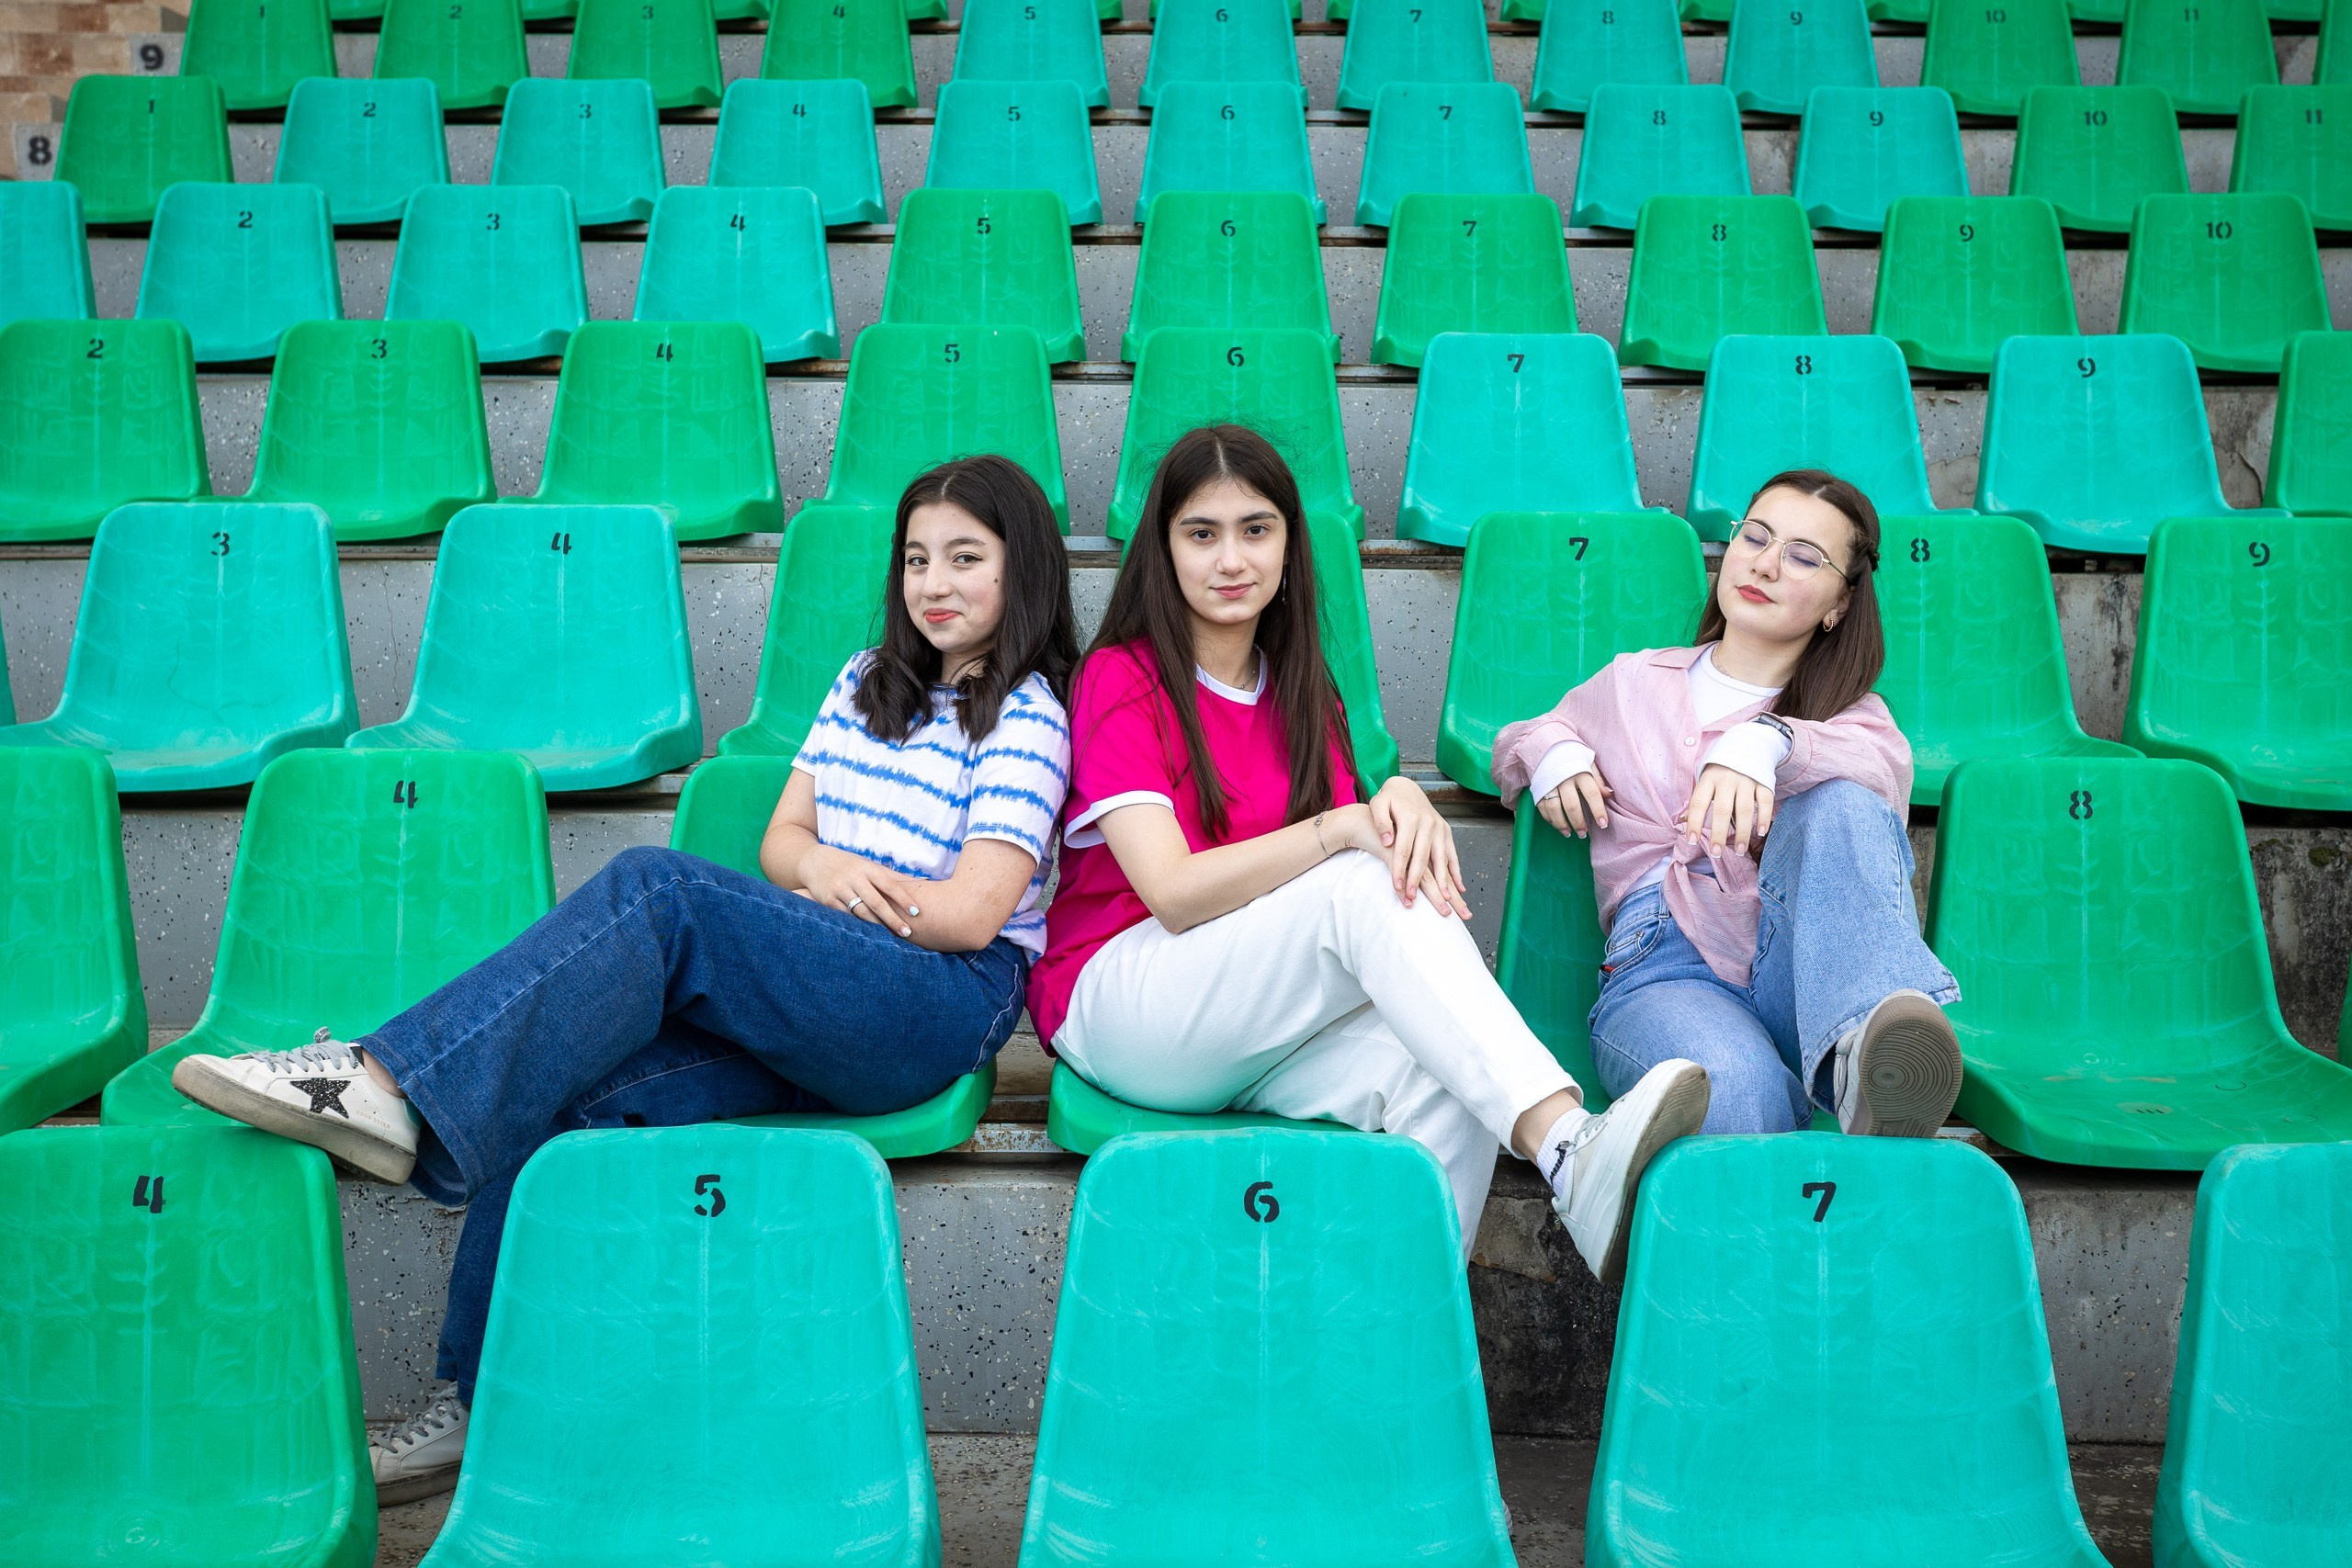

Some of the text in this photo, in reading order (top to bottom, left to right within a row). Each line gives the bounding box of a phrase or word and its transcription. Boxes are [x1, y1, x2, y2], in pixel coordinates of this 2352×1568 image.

[258, 4, 266, 19] 1
[448, 5, 463, 20] 2
[641, 5, 655, 20] 3
[831, 5, 846, 19] 4
[1023, 6, 1036, 21] 5
[1215, 8, 1229, 23] 6
[1408, 8, 1423, 24] 7
[1601, 10, 1615, 25] 8
[1790, 11, 1804, 27] 9
[1984, 9, 2007, 24] 10
[2183, 7, 2200, 23] 11
[140, 43, 165, 72] 9
[148, 98, 156, 115] 1
[362, 101, 377, 118] 2
[579, 103, 593, 119] 3
[792, 103, 807, 118] 4
[1007, 106, 1022, 122] 5
[1220, 105, 1236, 120] 6
[1438, 105, 1453, 120] 7
[1652, 109, 1667, 126] 8
[1869, 110, 1884, 127] 9
[2084, 110, 2109, 126] 10
[2304, 108, 2323, 125] 11
[28, 135, 52, 165] 8
[237, 210, 254, 230] 2
[485, 212, 501, 231] 3
[729, 213, 746, 231] 4
[977, 217, 991, 235] 5
[1220, 220, 1237, 237] 6
[1462, 220, 1478, 238] 7
[1712, 223, 1727, 243] 8
[1959, 223, 1975, 243] 9
[2206, 221, 2233, 240] 10
[85, 338, 105, 359] 2
[370, 338, 388, 359] 3
[655, 343, 674, 363] 4
[944, 343, 961, 364] 5
[1227, 346, 1245, 367] 6
[1507, 353, 1525, 374] 7
[1795, 355, 1813, 376] 8
[2076, 357, 2097, 378] 9
[210, 531, 231, 557] 3
[550, 532, 572, 556] 4
[1568, 536, 1589, 561] 7
[1910, 537, 1931, 563] 8
[2248, 541, 2271, 568] 9
[392, 780, 419, 809] 4
[2068, 790, 2094, 820] 8
[132, 1175, 164, 1214] 4
[694, 1173, 727, 1218] 5
[1243, 1180, 1280, 1224] 6
[1802, 1181, 1838, 1223] 7
